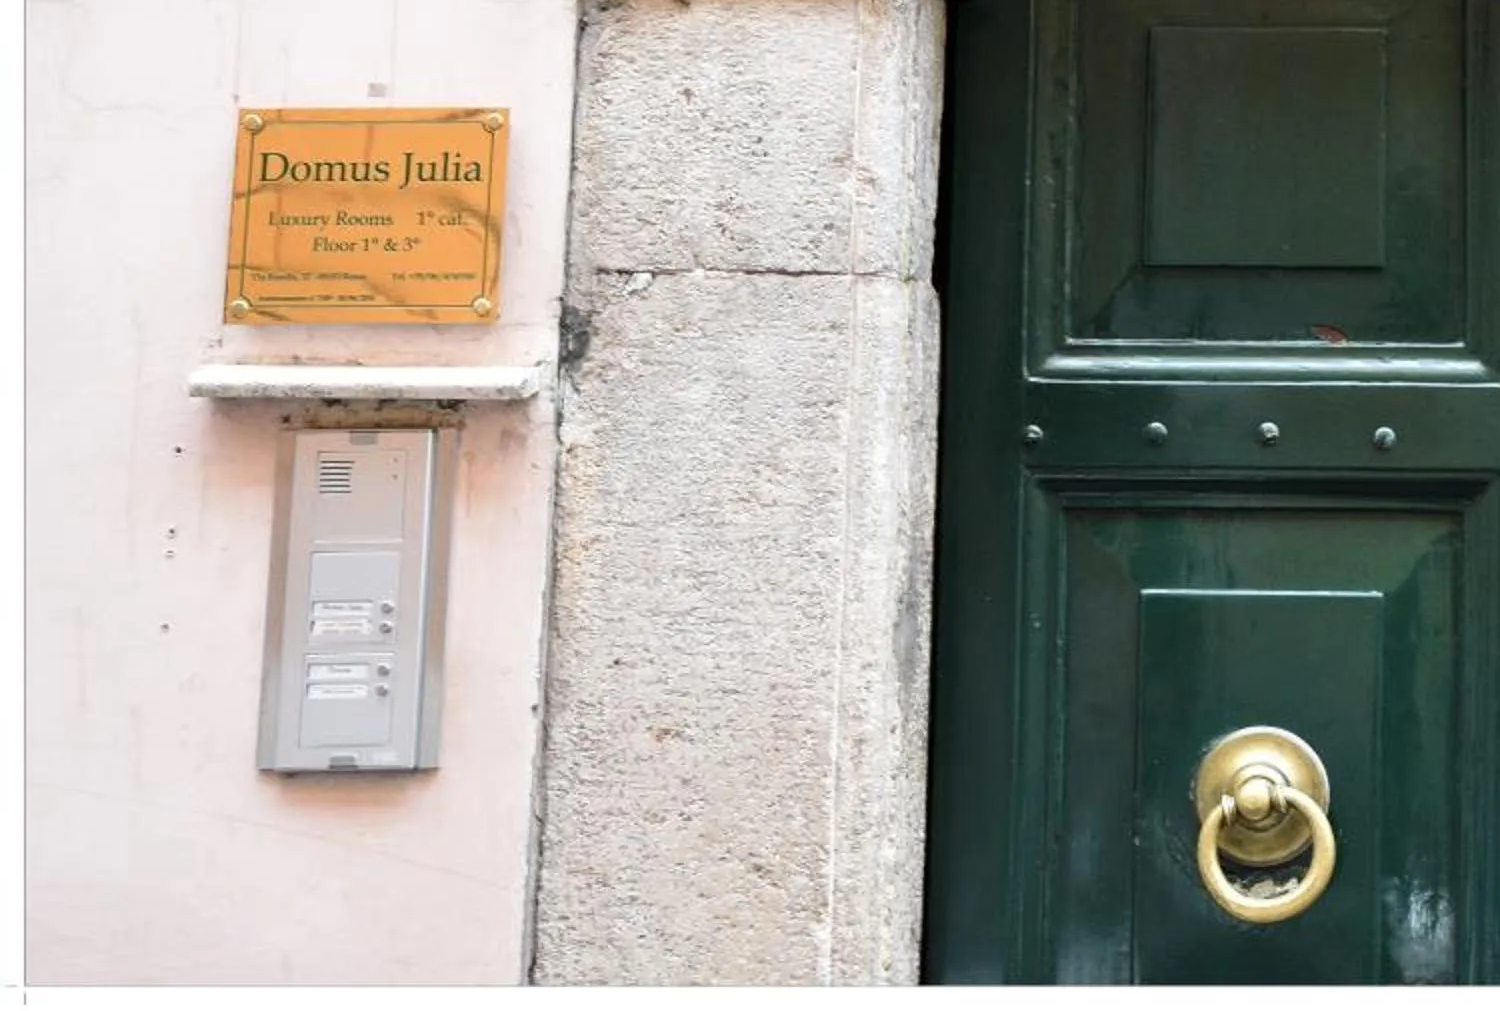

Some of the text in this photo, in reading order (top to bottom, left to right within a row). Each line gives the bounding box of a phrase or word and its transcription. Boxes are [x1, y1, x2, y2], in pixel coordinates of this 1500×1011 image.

[259, 152, 483, 190] Domus Julia
[268, 211, 330, 228] Luxury
[335, 210, 394, 226] Rooms
[312, 236, 357, 253] Floor
[383, 238, 398, 252] &
